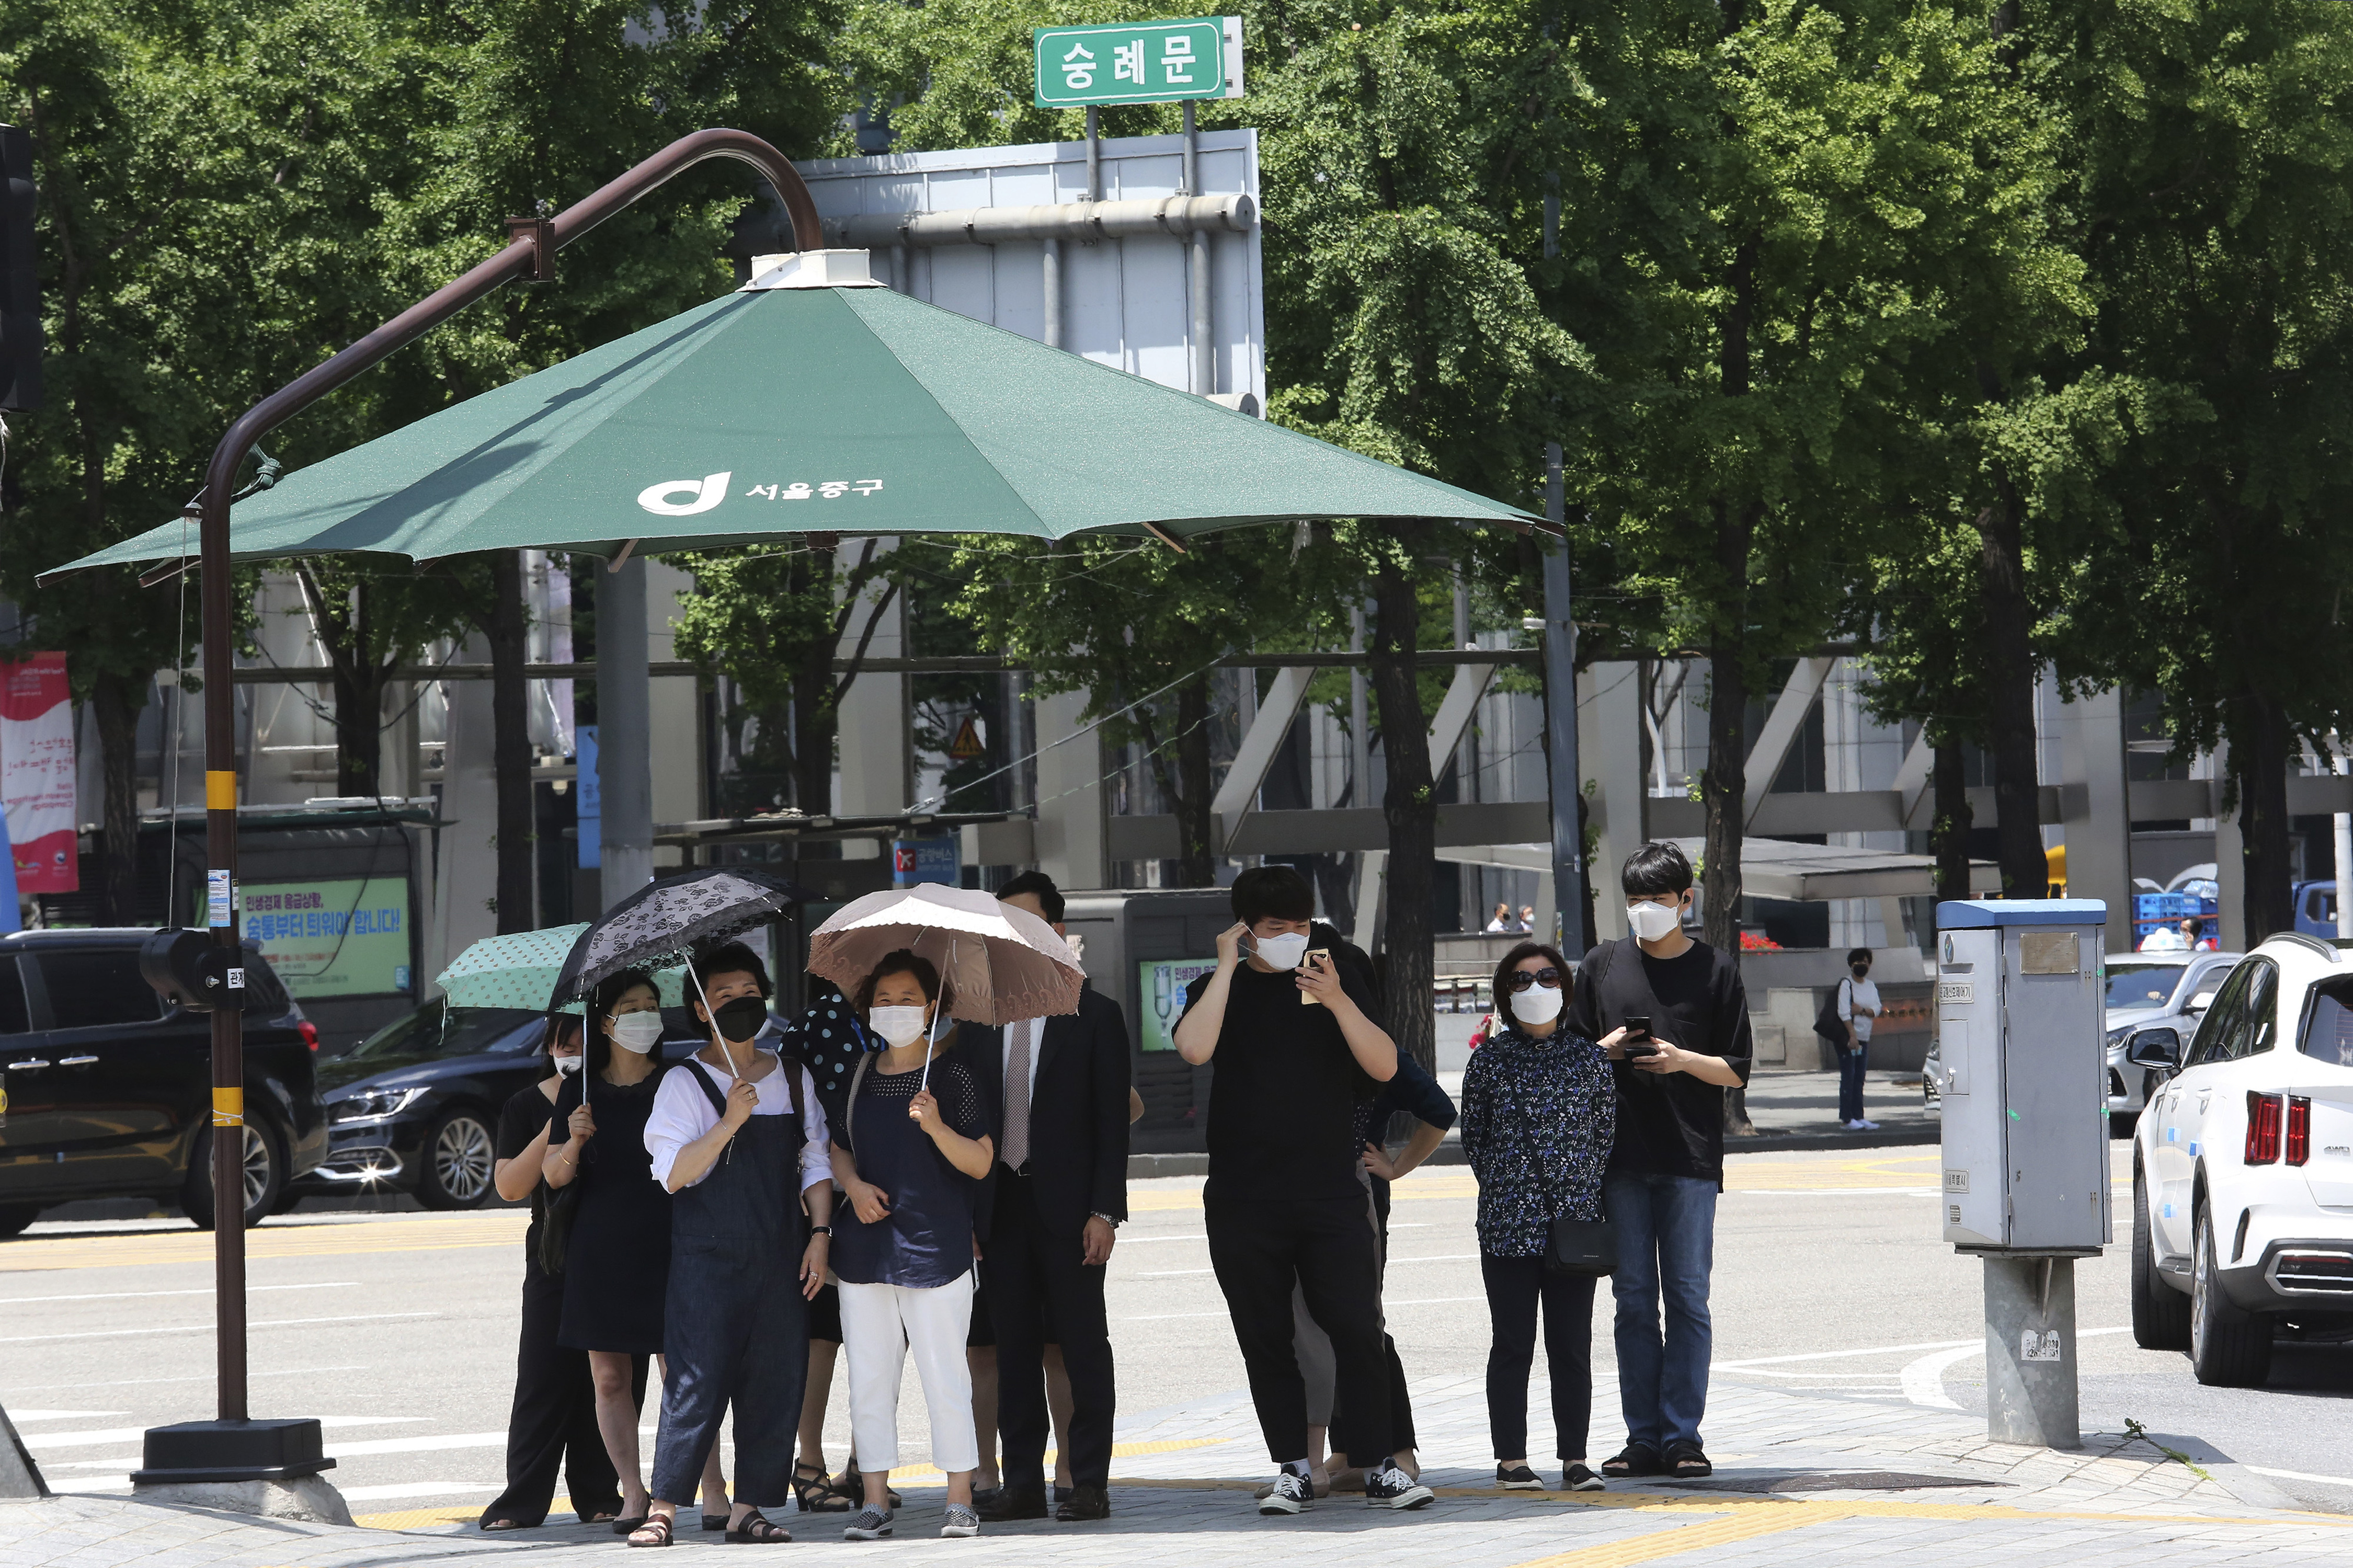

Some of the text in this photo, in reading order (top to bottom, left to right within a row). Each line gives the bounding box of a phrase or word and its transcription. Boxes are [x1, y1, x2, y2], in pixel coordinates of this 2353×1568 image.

[1061, 36, 1196, 89] 숭례문
[745, 479, 884, 500] 서울중구
[918, 848, 953, 863] 공항버스
[246, 894, 282, 912] 민생경제
[284, 892, 324, 910] 응급상황,
[247, 908, 401, 941] 숨통부터 틔워야 합니다!
[1175, 966, 1202, 981] 민생경제
